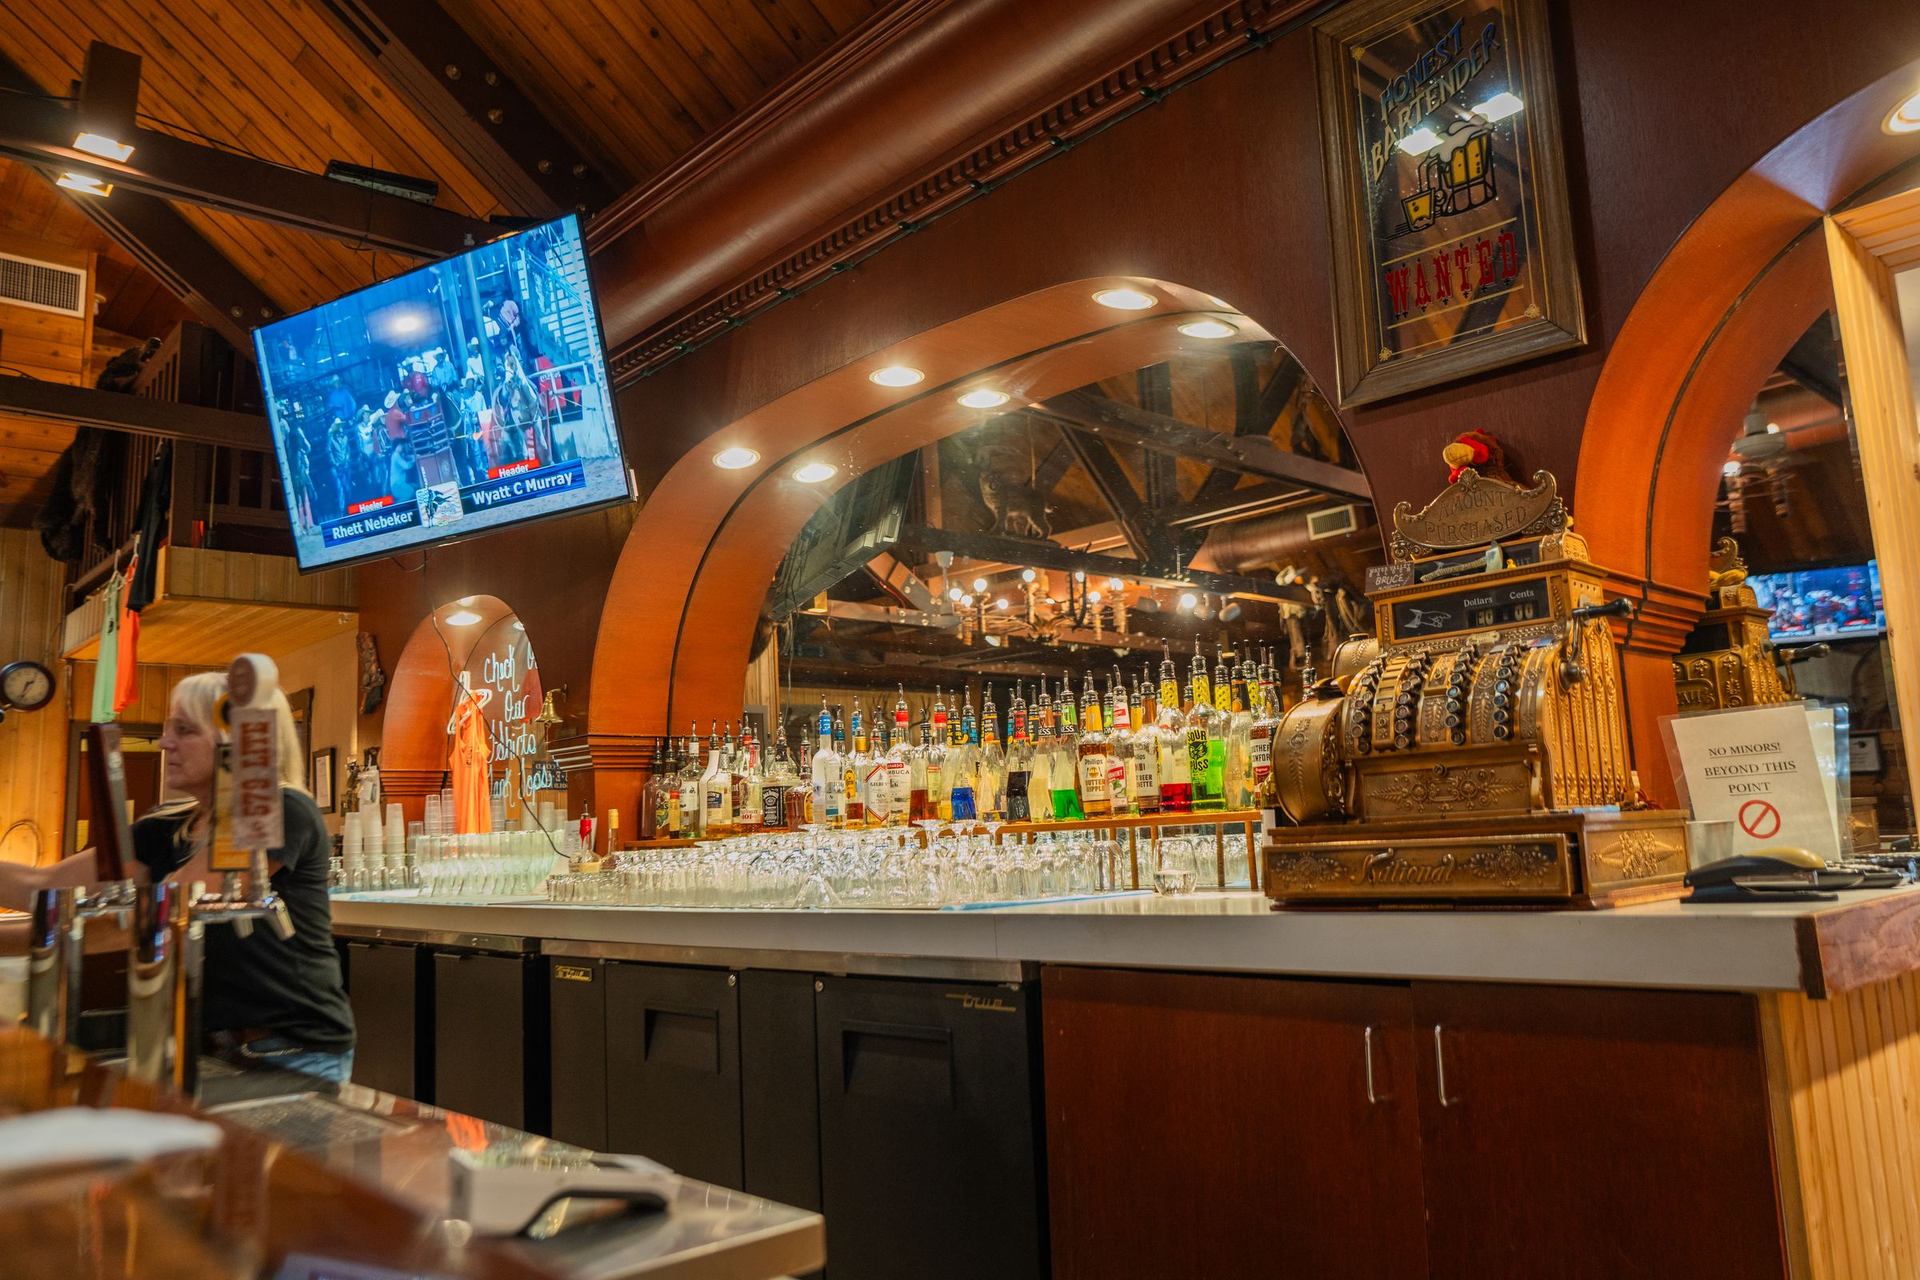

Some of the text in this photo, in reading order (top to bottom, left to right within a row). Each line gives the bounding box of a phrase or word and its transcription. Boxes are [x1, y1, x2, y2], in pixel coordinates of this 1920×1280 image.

[1380, 18, 1465, 121] HONEST
[1371, 22, 1500, 185] BARTENDER
[1385, 231, 1518, 318] WANTED
[498, 463, 529, 478] Header
[472, 472, 573, 505] Wyatt C Murray
[1441, 490, 1506, 517] AMOUNT
[332, 511, 413, 540] Rhett Nebeker
[1425, 506, 1527, 542] PURCHASED
[1375, 573, 1404, 586] BRUCE
[1463, 590, 1535, 608] Dollars Cents
[239, 720, 270, 768] LITE
[1187, 730, 1207, 742] SOUR
[1708, 742, 1780, 757] NO MINORS!
[1704, 760, 1797, 777] BEYOND THIS
[1728, 781, 1771, 794] POINT
[1351, 847, 1456, 887] National
